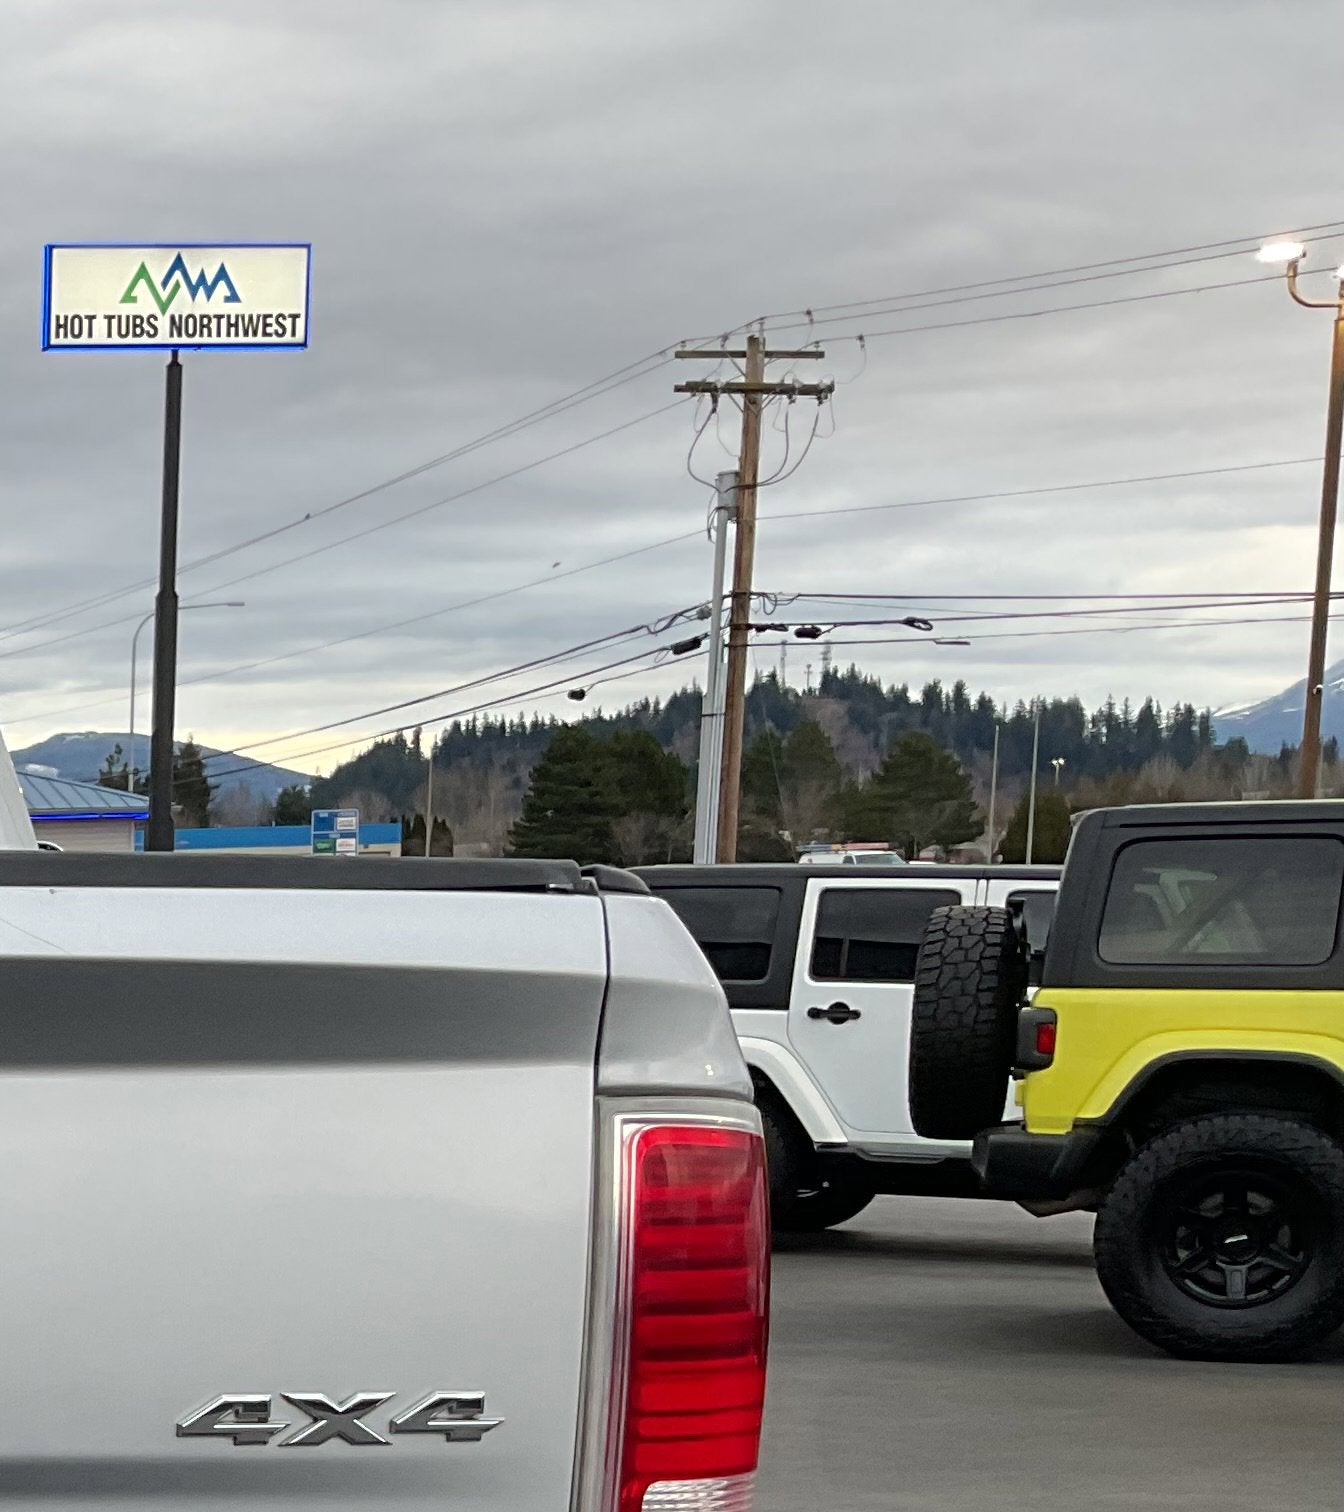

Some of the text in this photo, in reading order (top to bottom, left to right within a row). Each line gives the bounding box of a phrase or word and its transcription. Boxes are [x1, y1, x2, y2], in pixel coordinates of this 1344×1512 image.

[55, 313, 301, 339] HOT TUBS NORTHWEST
